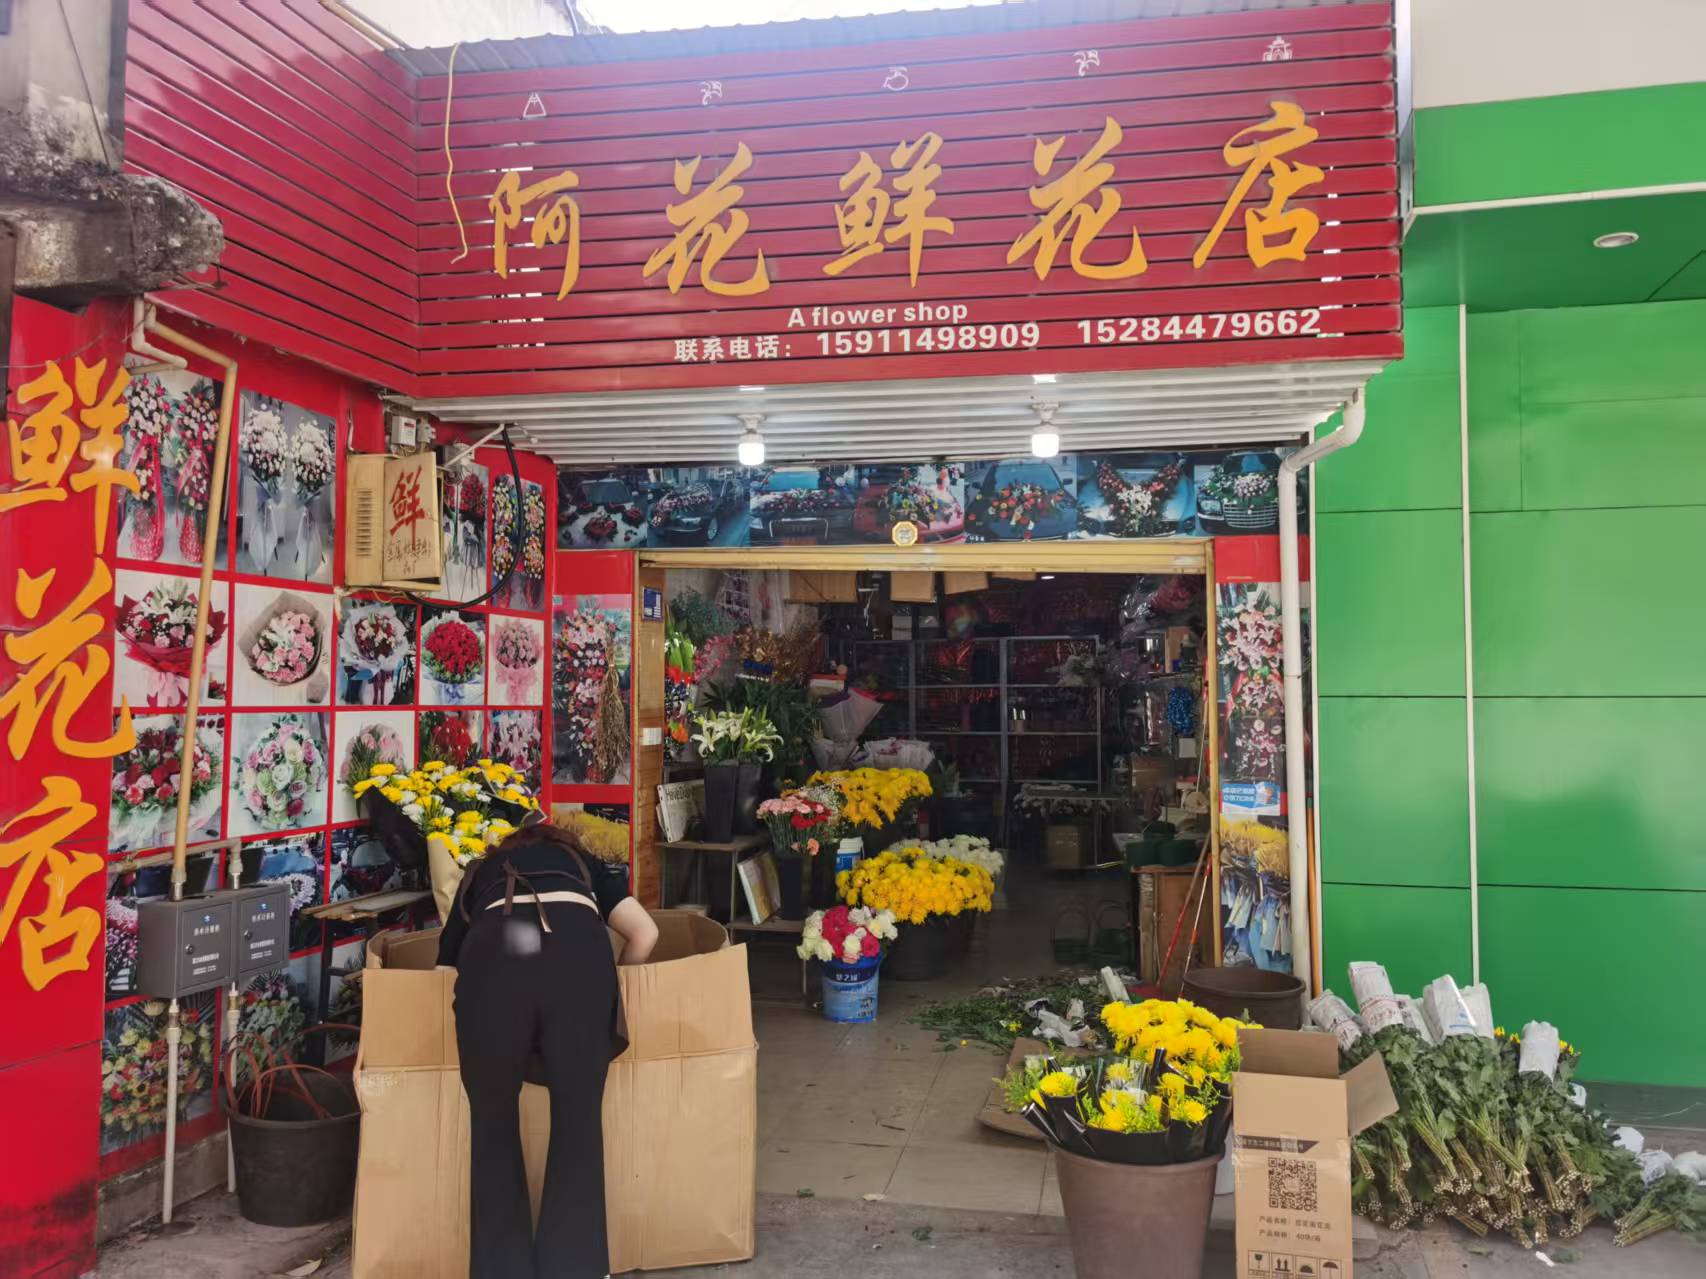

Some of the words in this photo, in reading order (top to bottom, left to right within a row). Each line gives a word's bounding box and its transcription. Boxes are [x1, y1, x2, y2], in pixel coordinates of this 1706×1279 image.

[488, 101, 1325, 301] 阿花鲜花店
[787, 307, 806, 328] A
[811, 306, 896, 326] flower
[903, 302, 969, 326] shop
[816, 323, 1041, 356] 15911498909
[1077, 310, 1321, 344] 15284479662
[0, 358, 141, 991] 鲜花店
